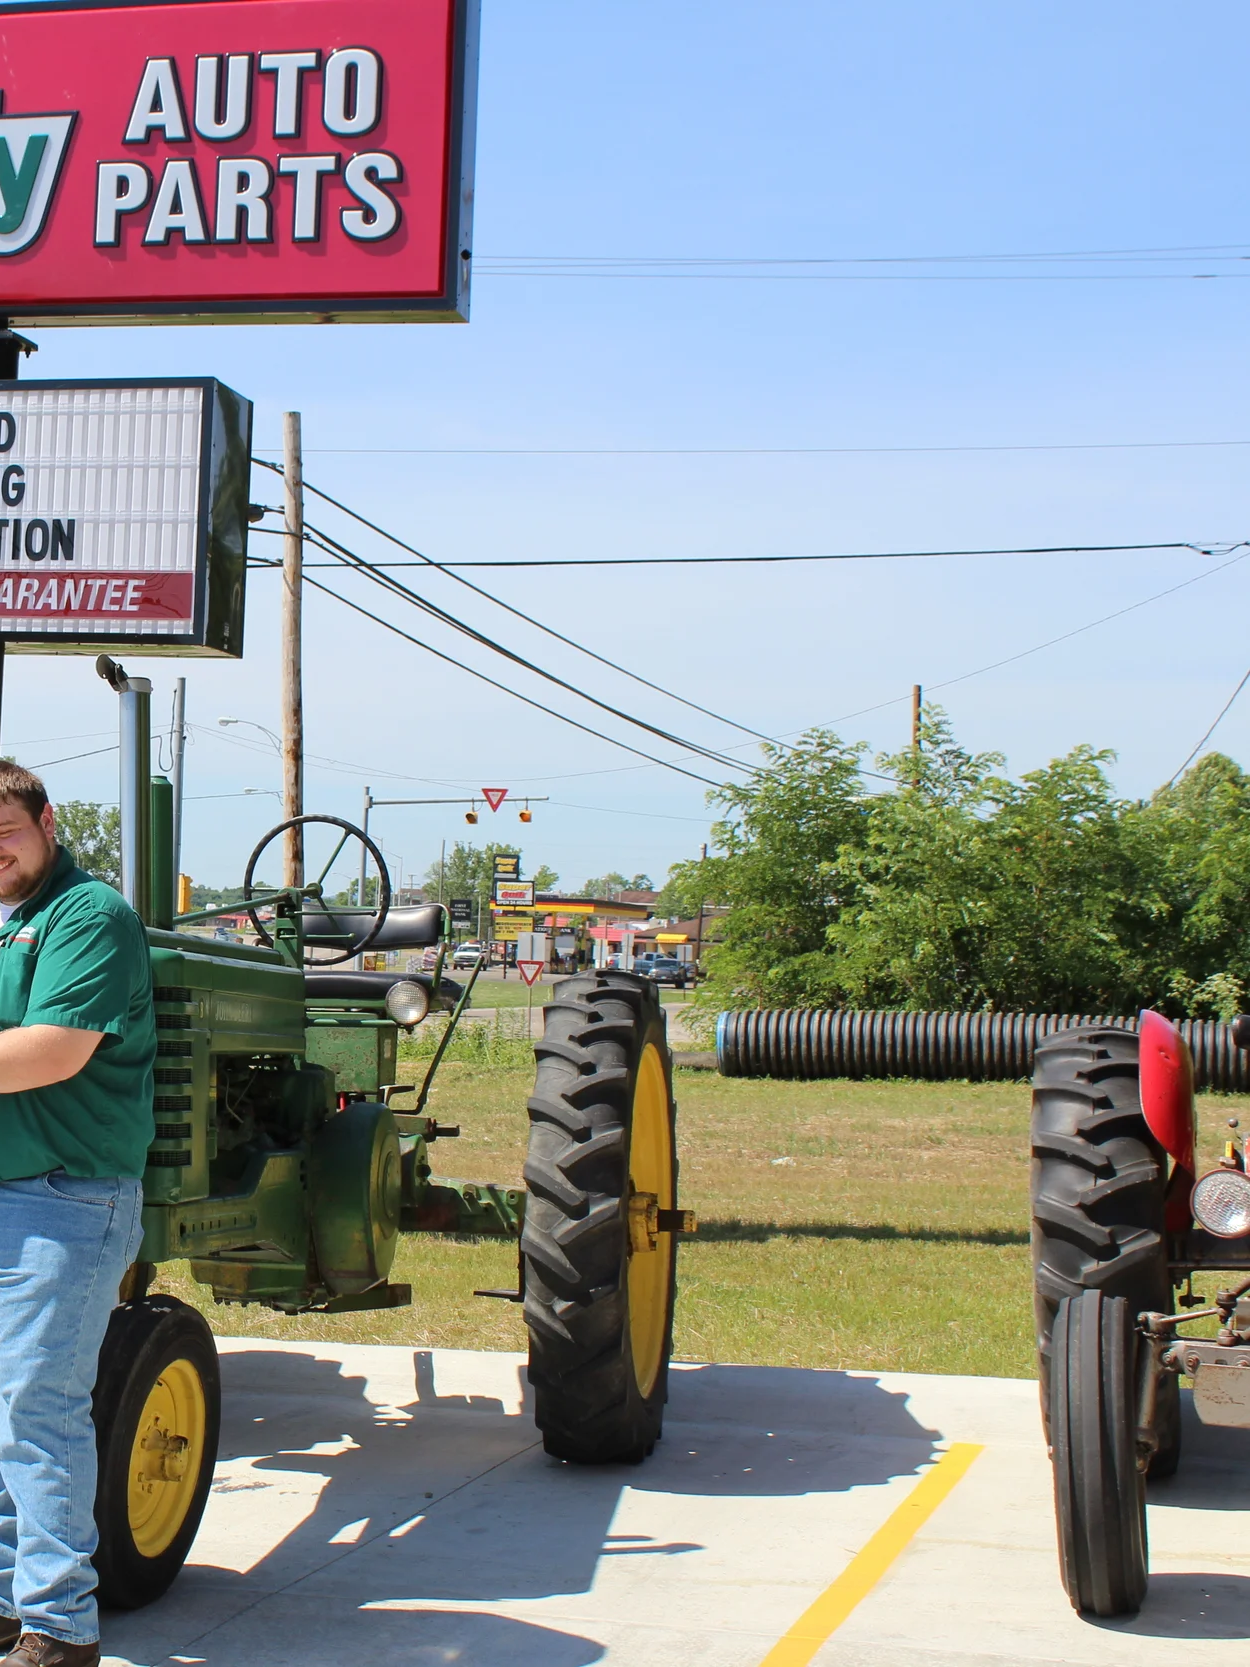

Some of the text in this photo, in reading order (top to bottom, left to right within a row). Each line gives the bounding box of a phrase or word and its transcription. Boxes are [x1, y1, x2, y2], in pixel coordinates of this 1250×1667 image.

[123, 46, 384, 145] AUTO
[94, 150, 404, 248] PARTS
[498, 883, 533, 891] Super
[501, 891, 527, 899] Quik
